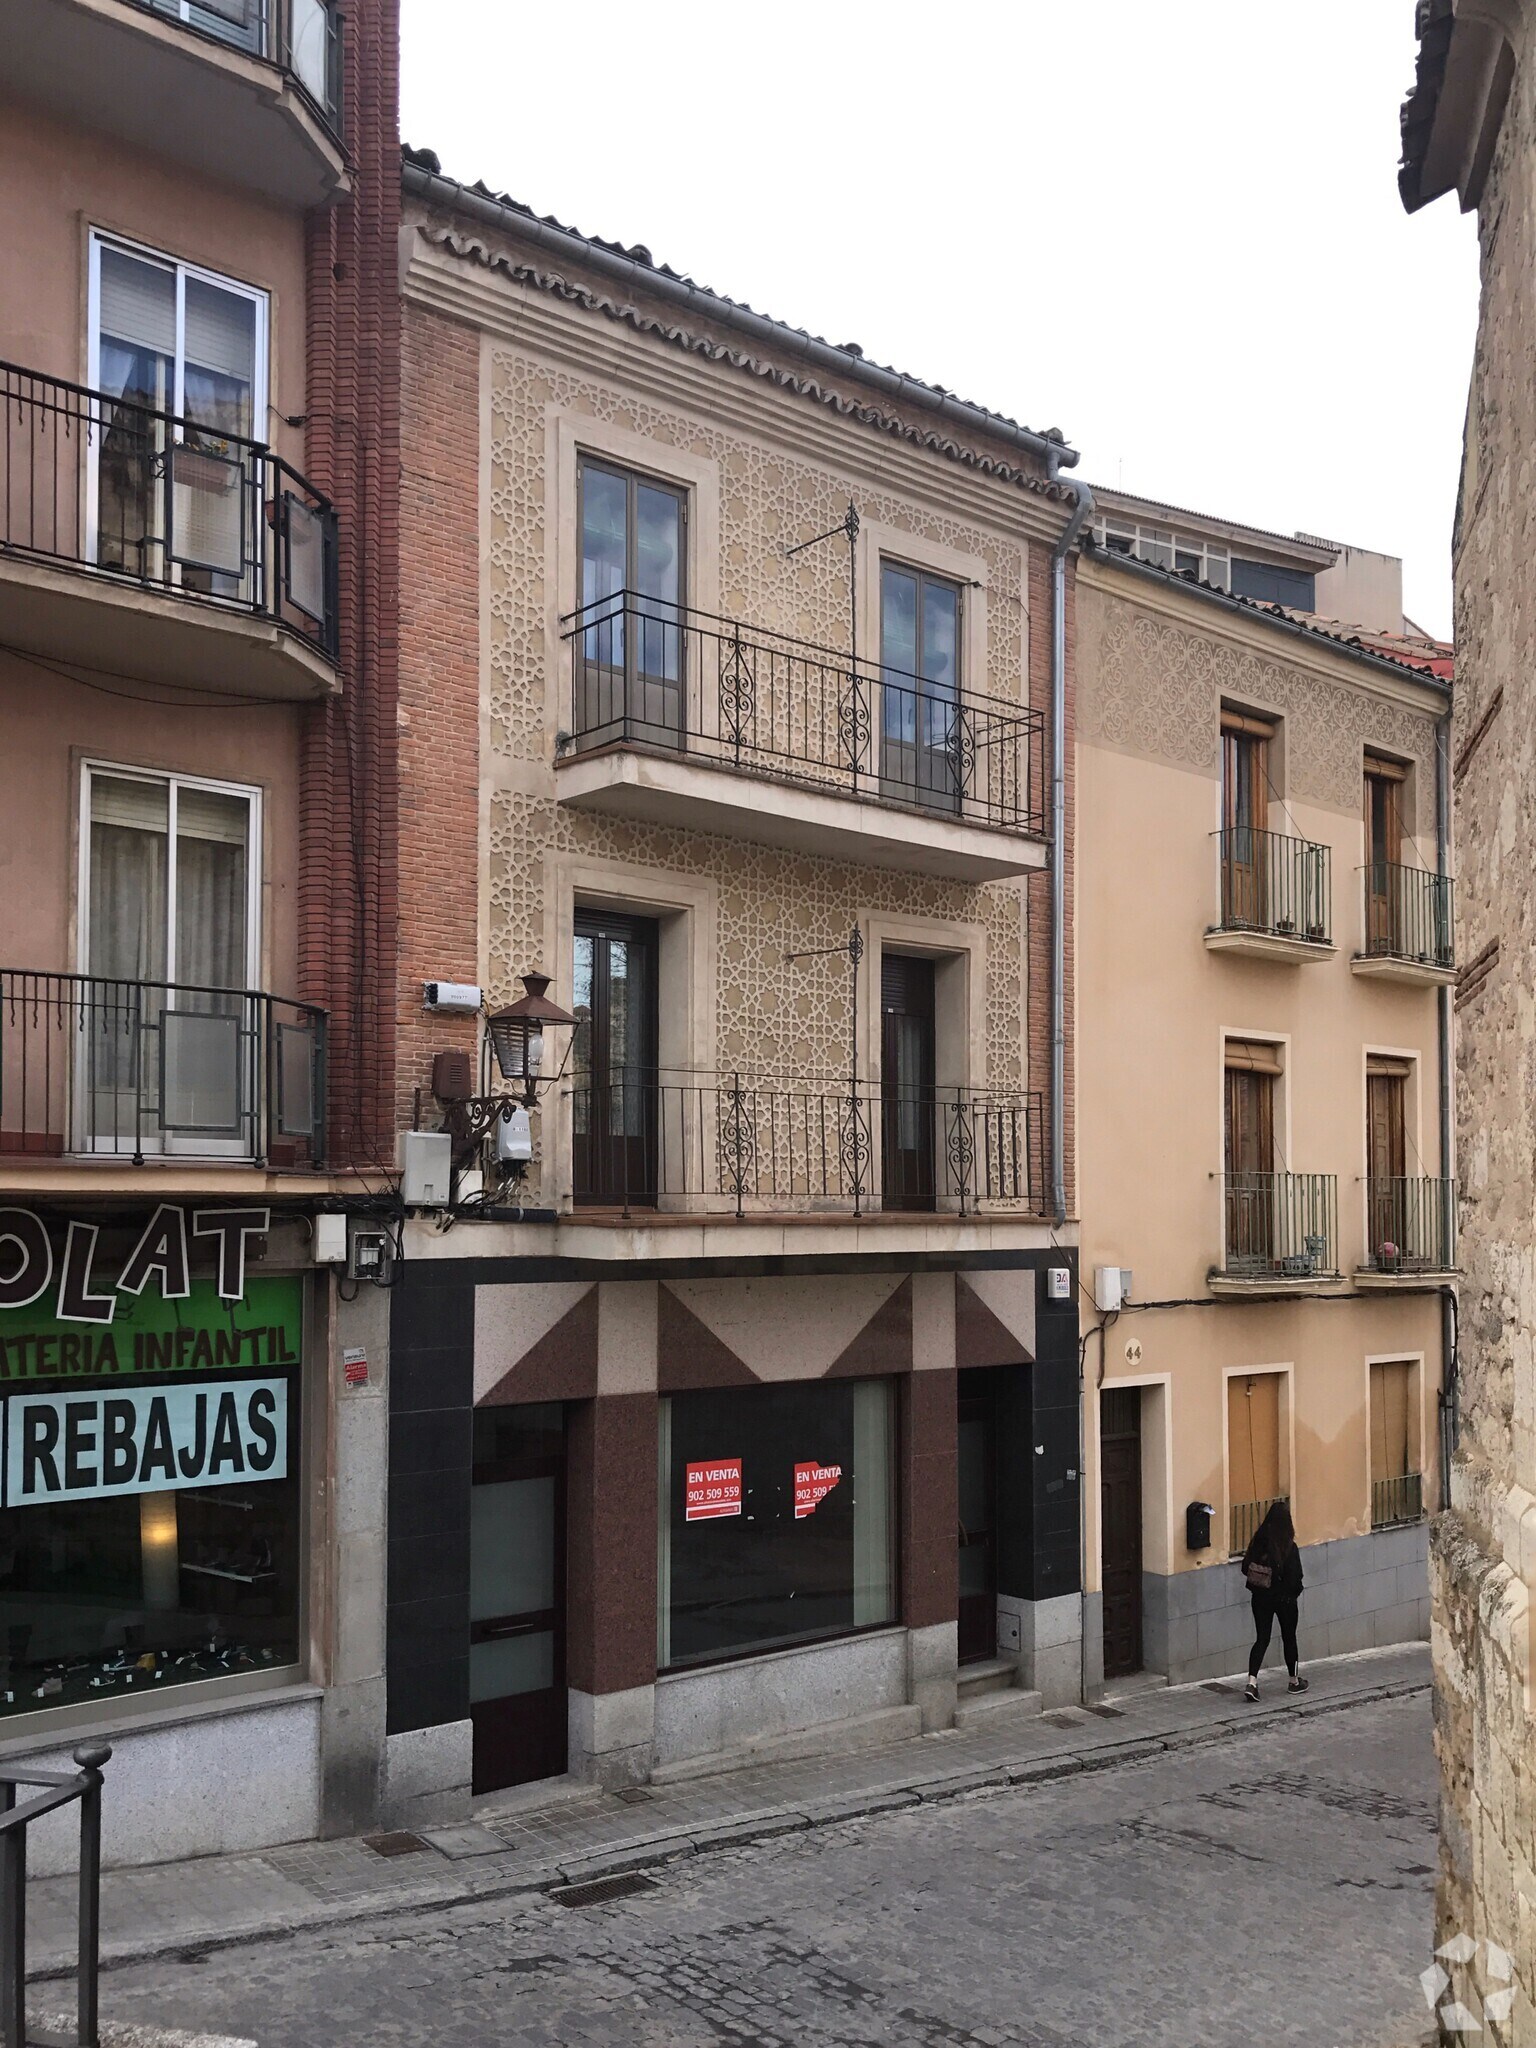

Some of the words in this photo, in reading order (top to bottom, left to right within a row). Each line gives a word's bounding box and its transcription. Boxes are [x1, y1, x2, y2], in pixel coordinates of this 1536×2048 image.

[0, 1204, 270, 1324] OLAT
[135, 1327, 296, 1370] INFANTIL
[1126, 1346, 1141, 1360] 44
[22, 1388, 277, 1495] REBAJAS
[689, 1471, 703, 1483] EN
[706, 1468, 740, 1481] VENTA
[796, 1471, 810, 1483] EN
[811, 1467, 842, 1480] VENTA
[688, 1490, 704, 1501] 902
[706, 1488, 722, 1500] 509
[724, 1486, 740, 1498] 559
[796, 1488, 811, 1500] 902
[812, 1486, 828, 1498] 509
